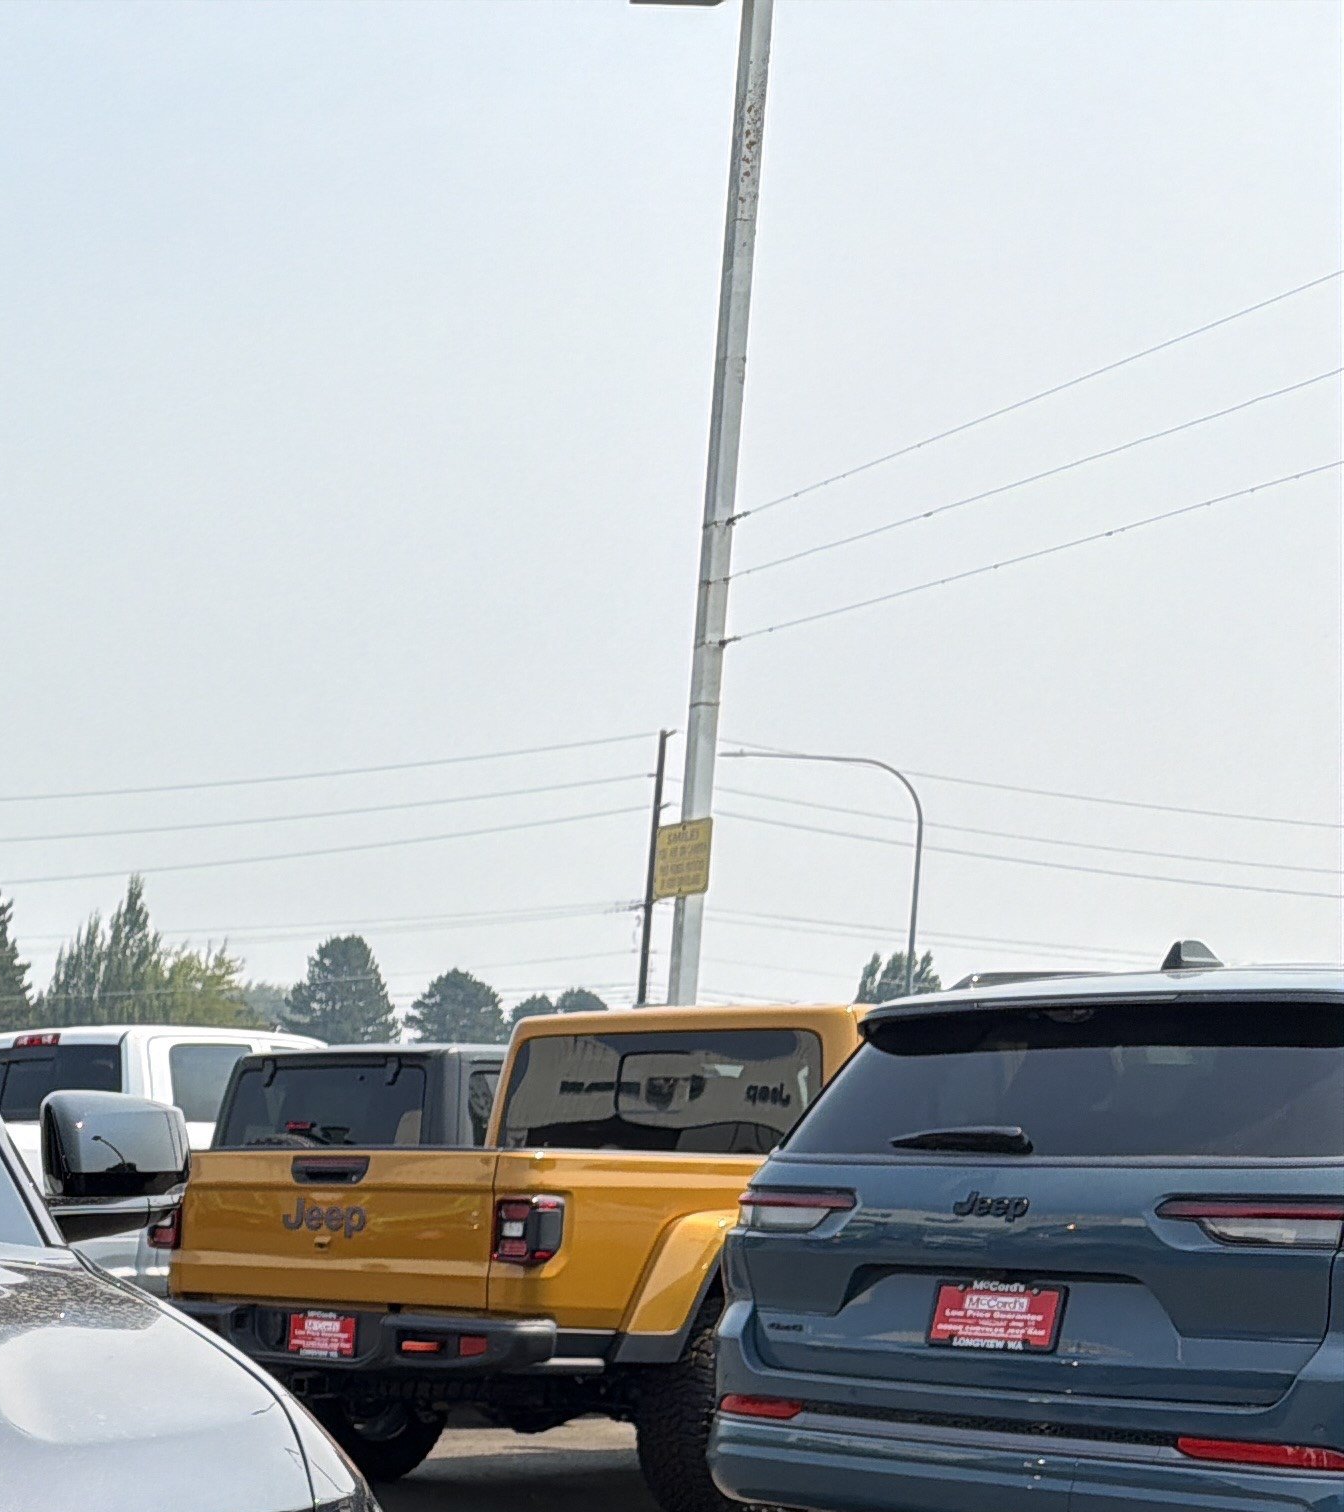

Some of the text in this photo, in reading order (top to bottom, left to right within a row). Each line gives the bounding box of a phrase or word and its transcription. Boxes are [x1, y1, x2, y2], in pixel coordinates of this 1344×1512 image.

[282, 1196, 367, 1239] Jeep
[953, 1191, 1030, 1222] Jeep
[973, 1280, 1025, 1293] McCord's
[967, 1297, 1024, 1311] McCord's
